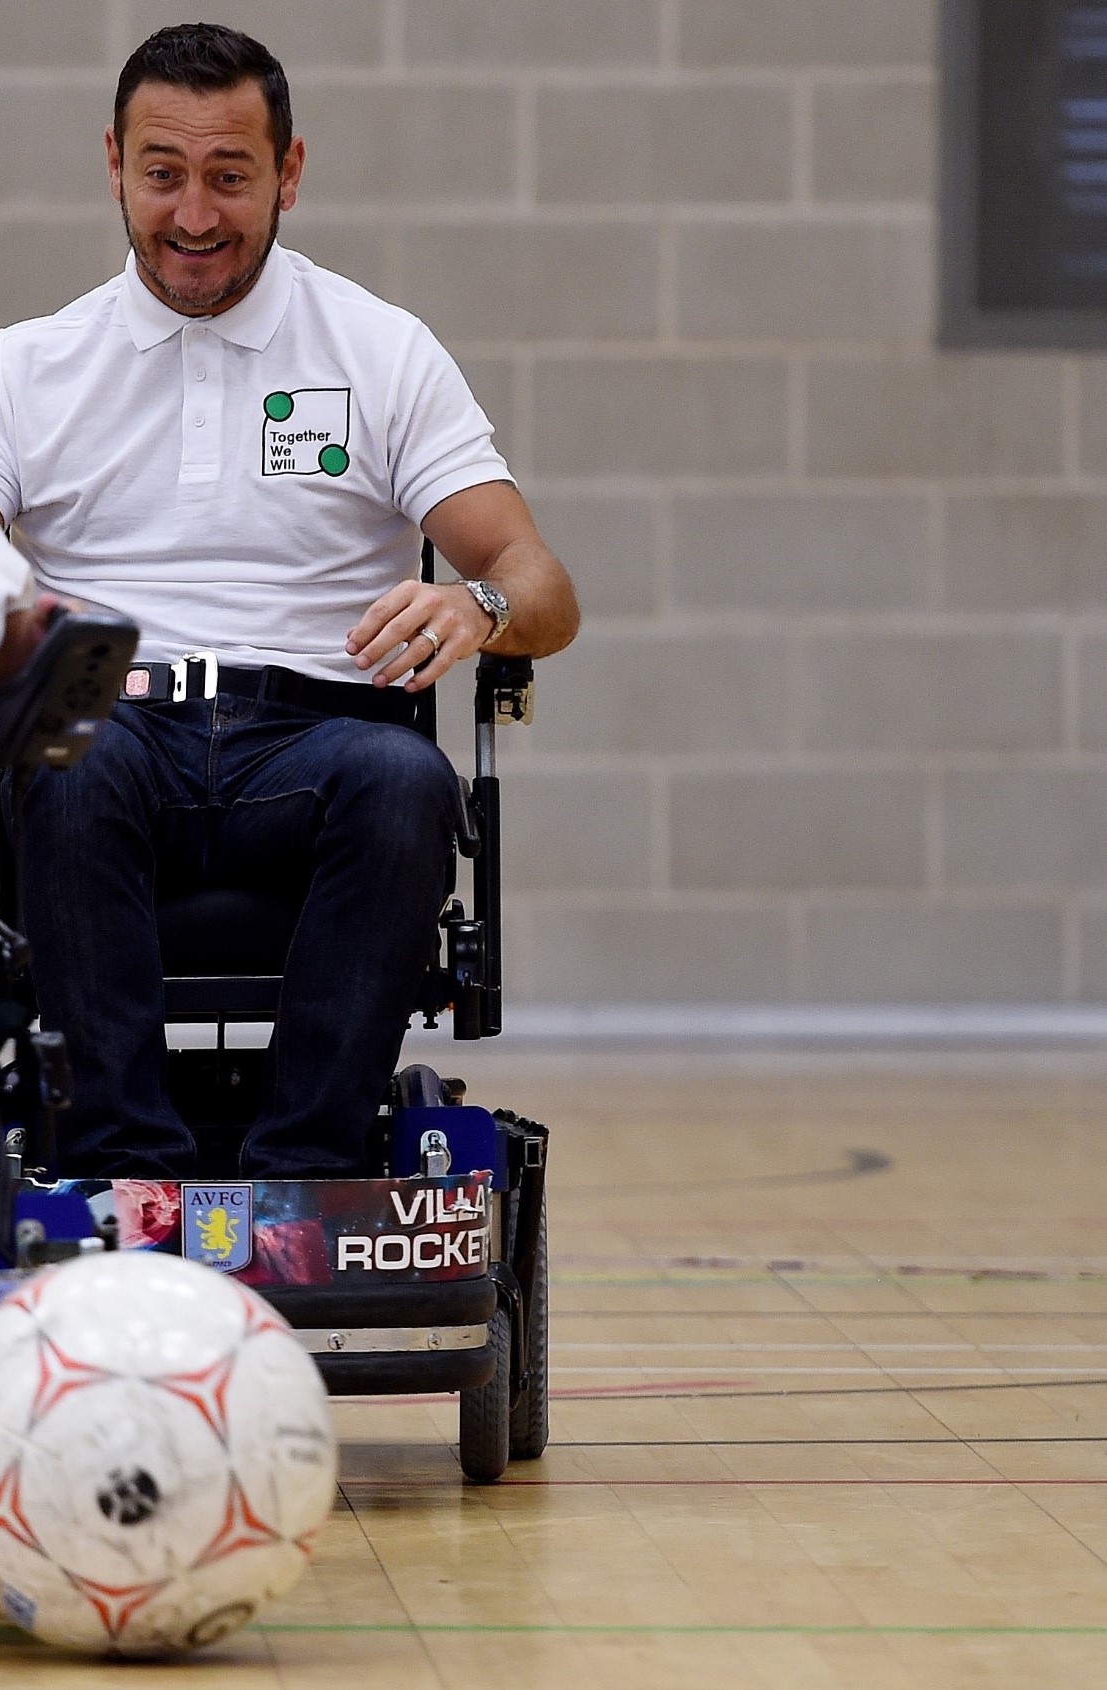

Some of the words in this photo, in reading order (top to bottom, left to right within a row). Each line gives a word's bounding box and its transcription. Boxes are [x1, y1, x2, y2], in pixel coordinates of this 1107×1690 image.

[269, 429, 331, 445] Together
[270, 445, 292, 457] We
[270, 459, 295, 471] Will
[191, 1191, 243, 1206] AVFC
[390, 1184, 486, 1225] VILLA
